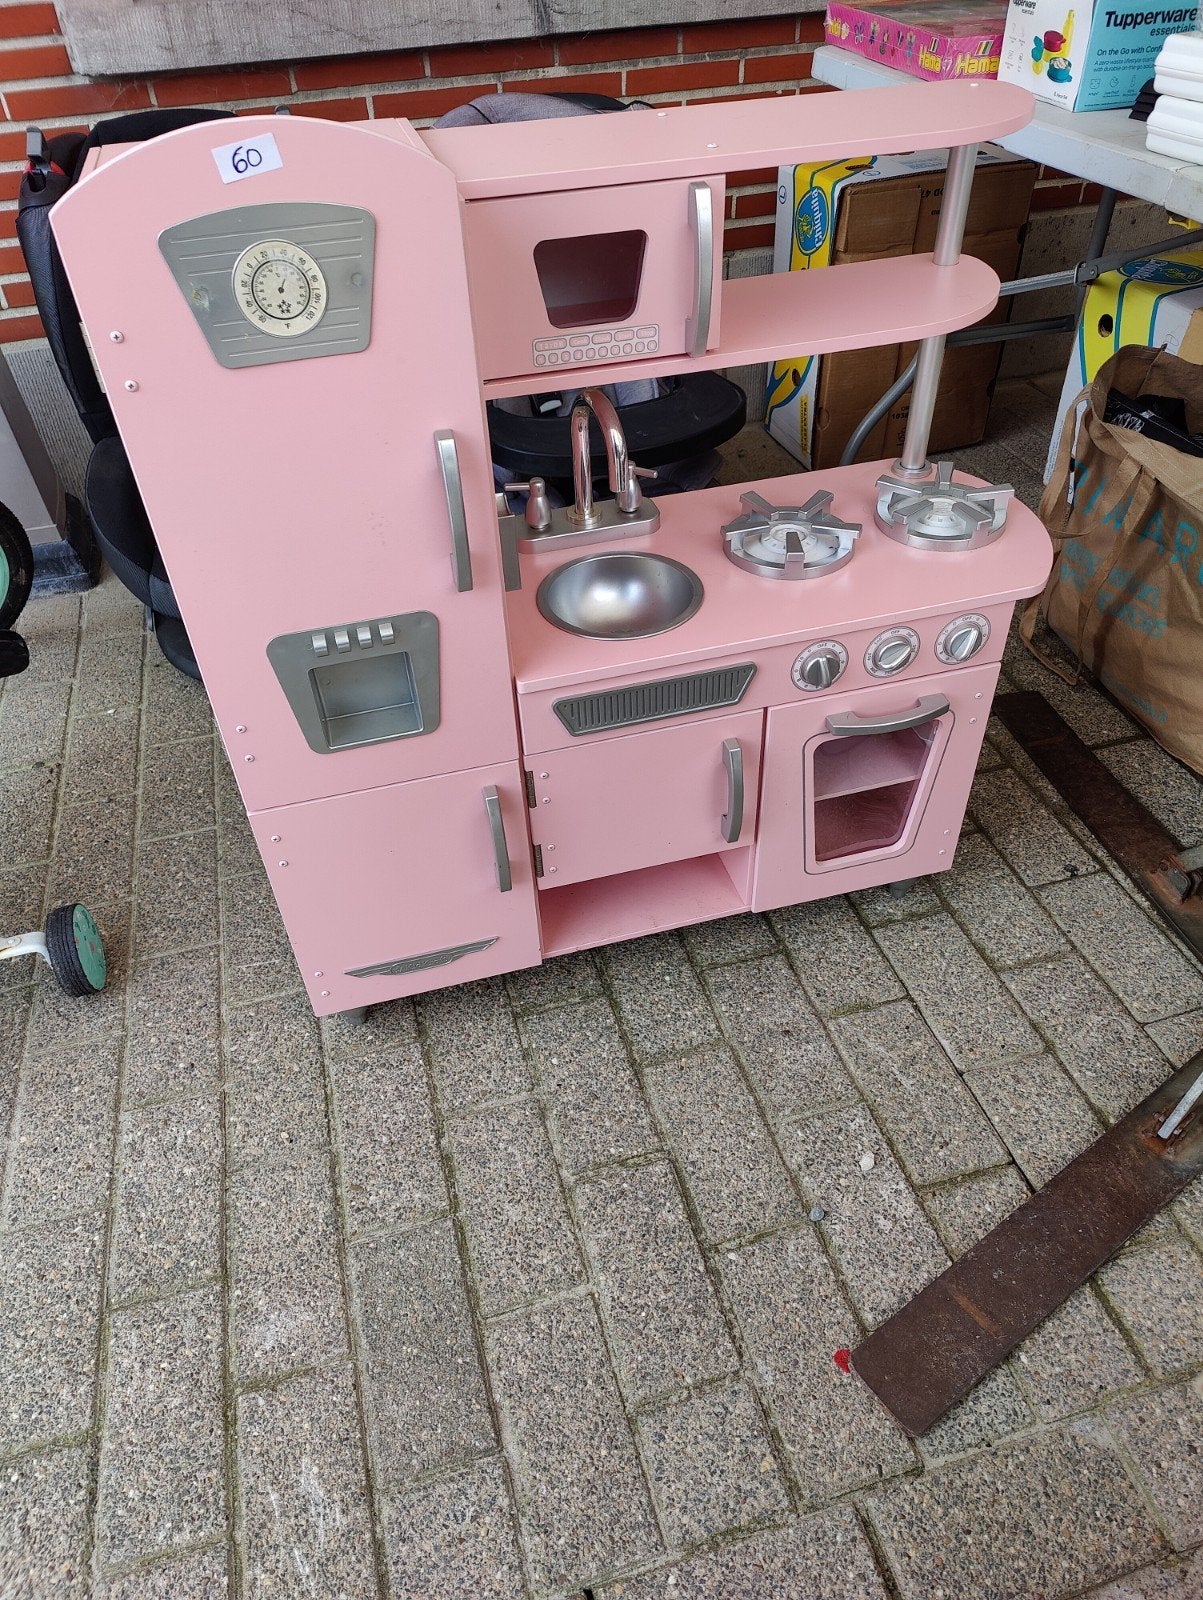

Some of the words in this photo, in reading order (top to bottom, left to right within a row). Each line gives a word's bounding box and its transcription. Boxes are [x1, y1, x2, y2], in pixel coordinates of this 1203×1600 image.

[1012, 0, 1037, 9] upperware
[1105, 8, 1198, 31] Tupperware
[1150, 24, 1196, 37] essentials
[919, 43, 942, 74] Hama
[1097, 48, 1107, 56] On
[1108, 47, 1119, 56] the
[1120, 47, 1130, 55] Go
[1131, 46, 1145, 55] with
[1146, 45, 1163, 54] Confi
[955, 51, 1000, 76] Hama
[231, 146, 263, 174] 60
[810, 187, 823, 249] Chiquita
